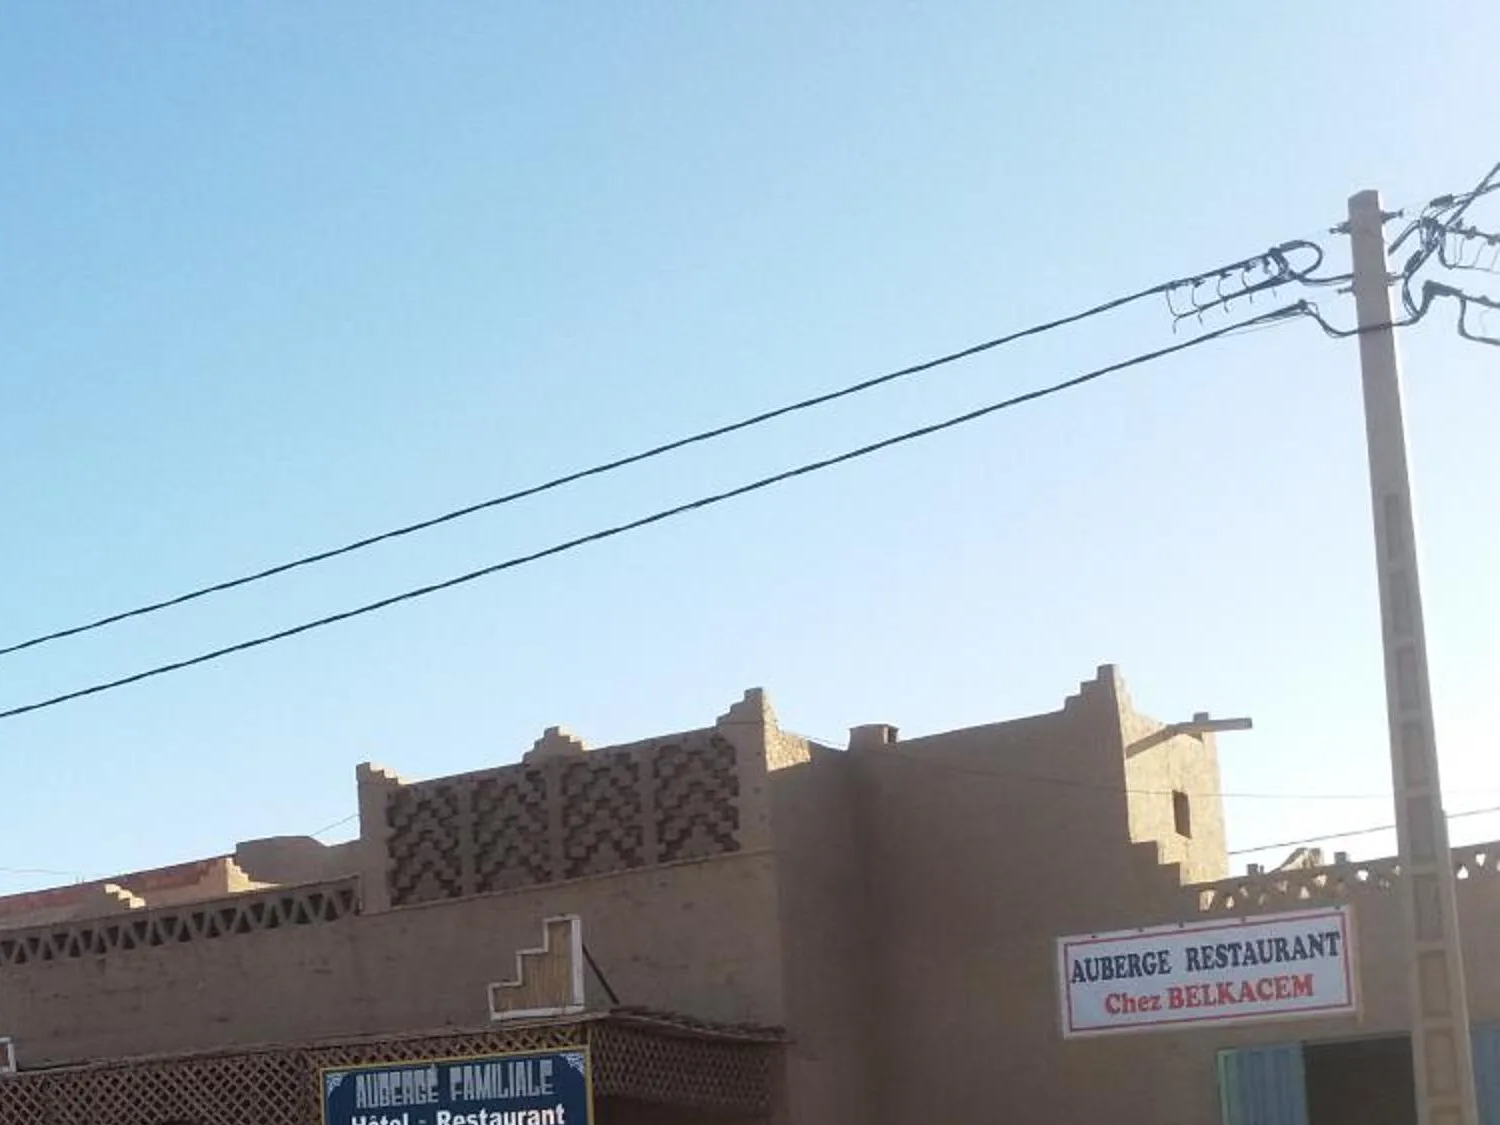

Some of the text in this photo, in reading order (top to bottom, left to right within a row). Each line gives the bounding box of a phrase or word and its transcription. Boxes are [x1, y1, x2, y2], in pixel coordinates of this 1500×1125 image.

[1071, 931, 1341, 984] AUBERGE RESTAURANT
[1104, 973, 1314, 1015] Chez BELKACEM
[450, 1060, 555, 1102] FAMILIALE
